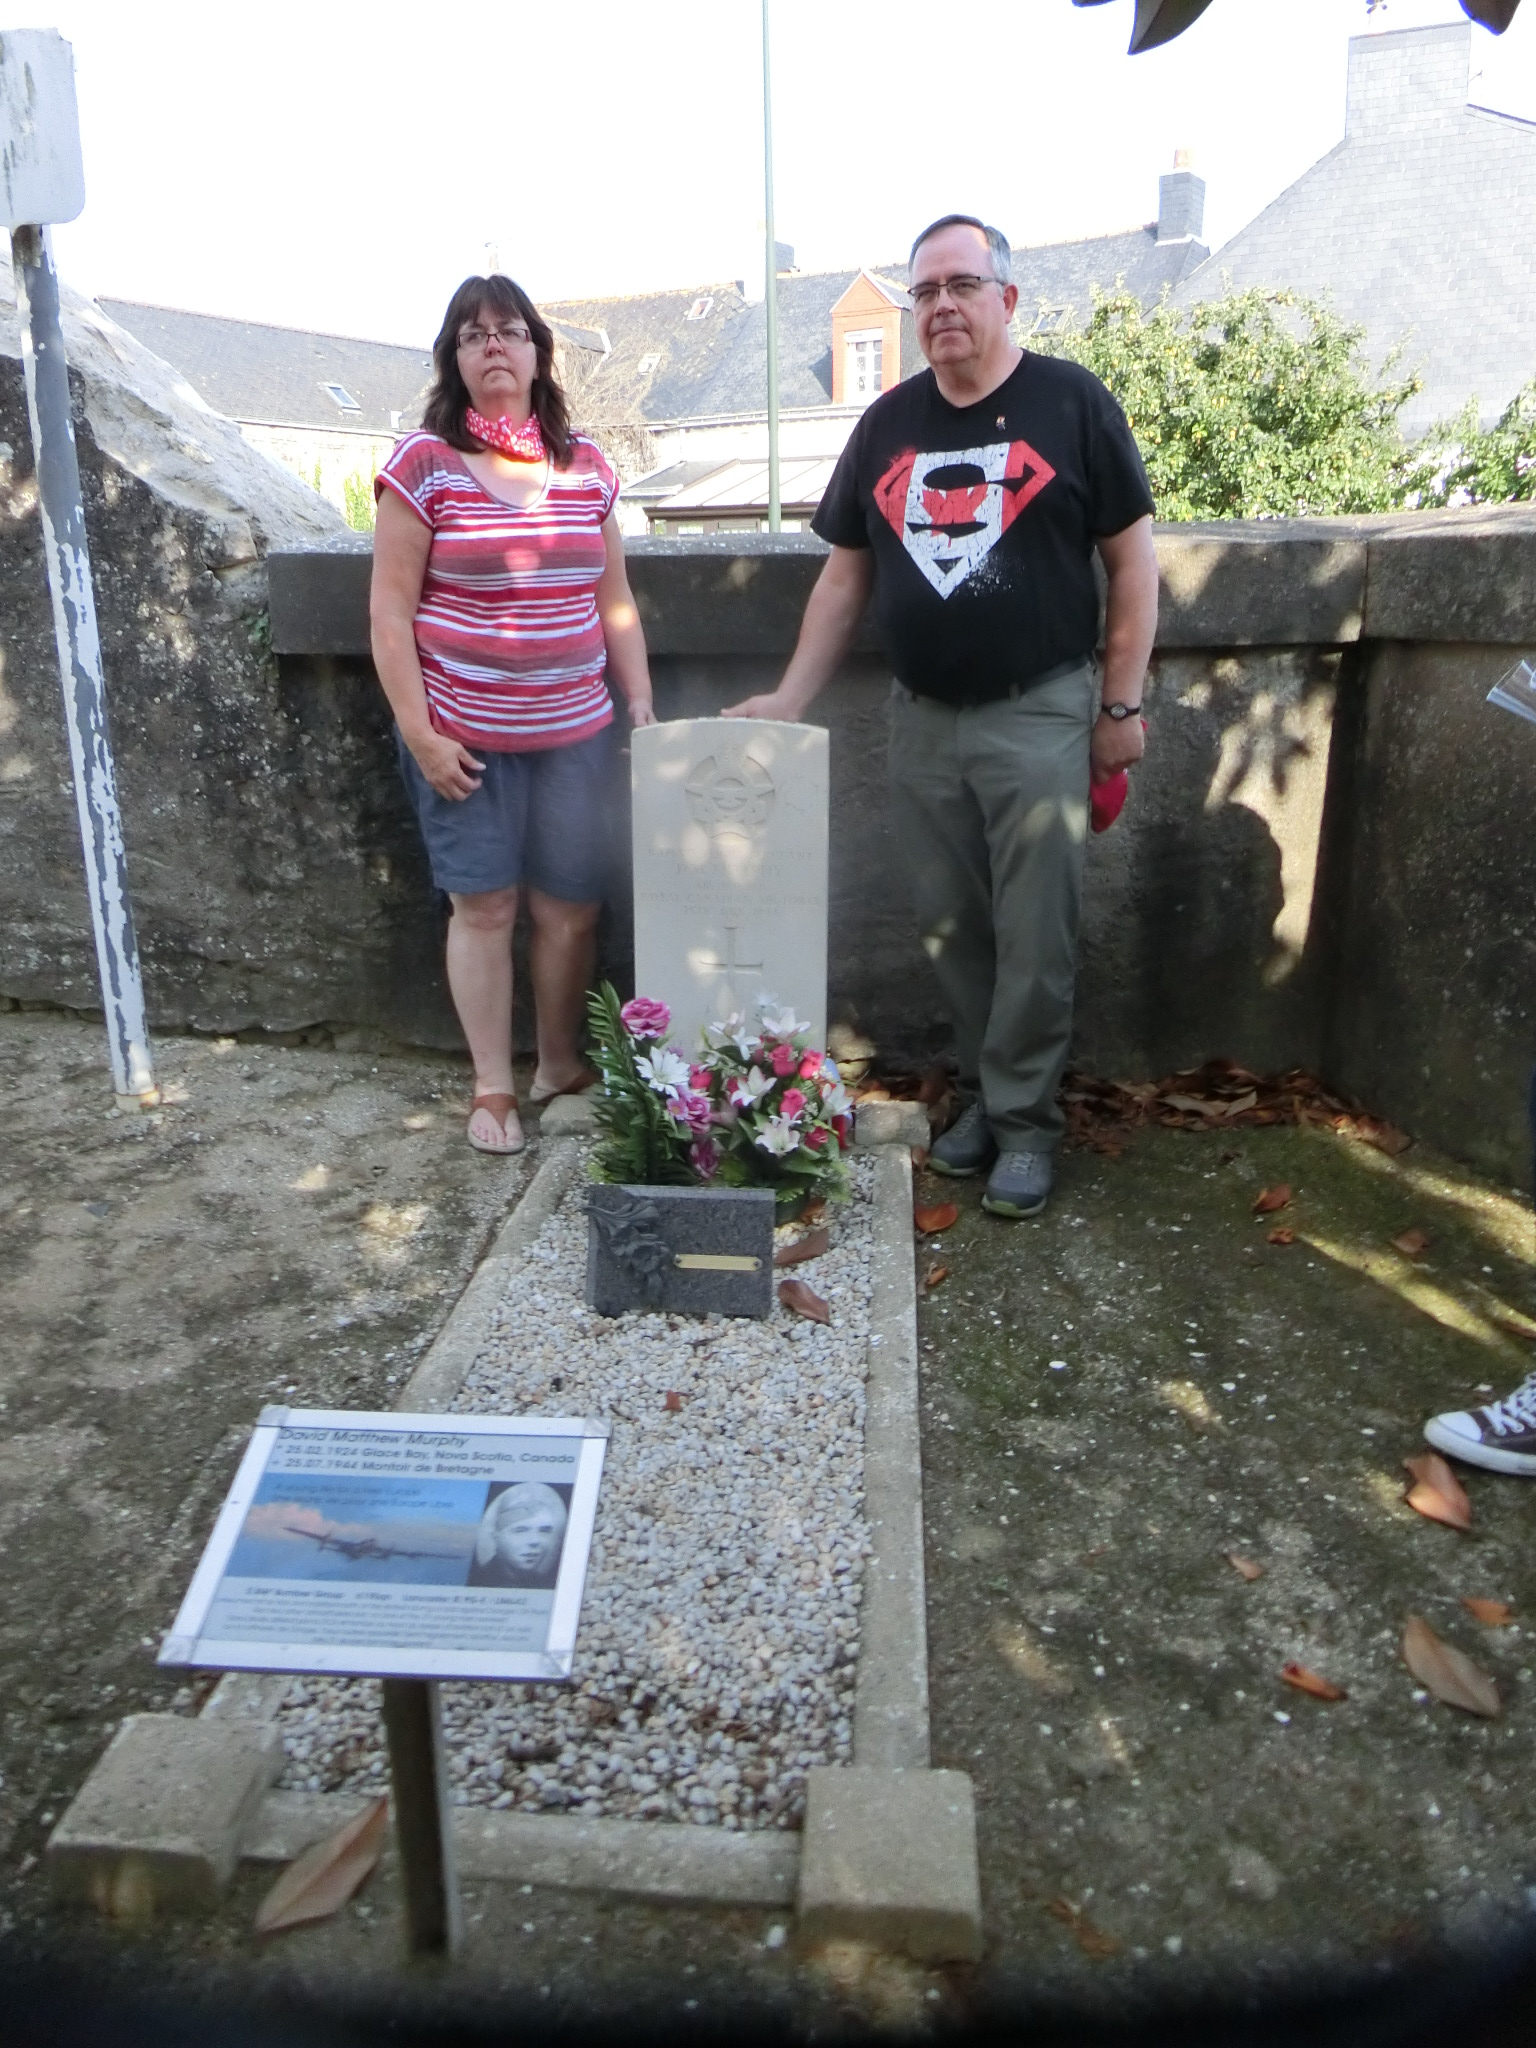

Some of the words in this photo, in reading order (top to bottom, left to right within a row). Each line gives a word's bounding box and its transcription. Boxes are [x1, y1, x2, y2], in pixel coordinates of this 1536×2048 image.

[280, 1429, 328, 1441] David
[331, 1431, 403, 1444] Matthew
[406, 1434, 469, 1448] Murphy
[362, 1448, 401, 1458] Glace
[435, 1451, 468, 1460] Nova
[472, 1452, 516, 1463] Scotia,
[521, 1453, 576, 1463] Canada
[362, 1461, 409, 1472] Montoir
[413, 1463, 432, 1473] de
[435, 1465, 495, 1476] Bretagne
